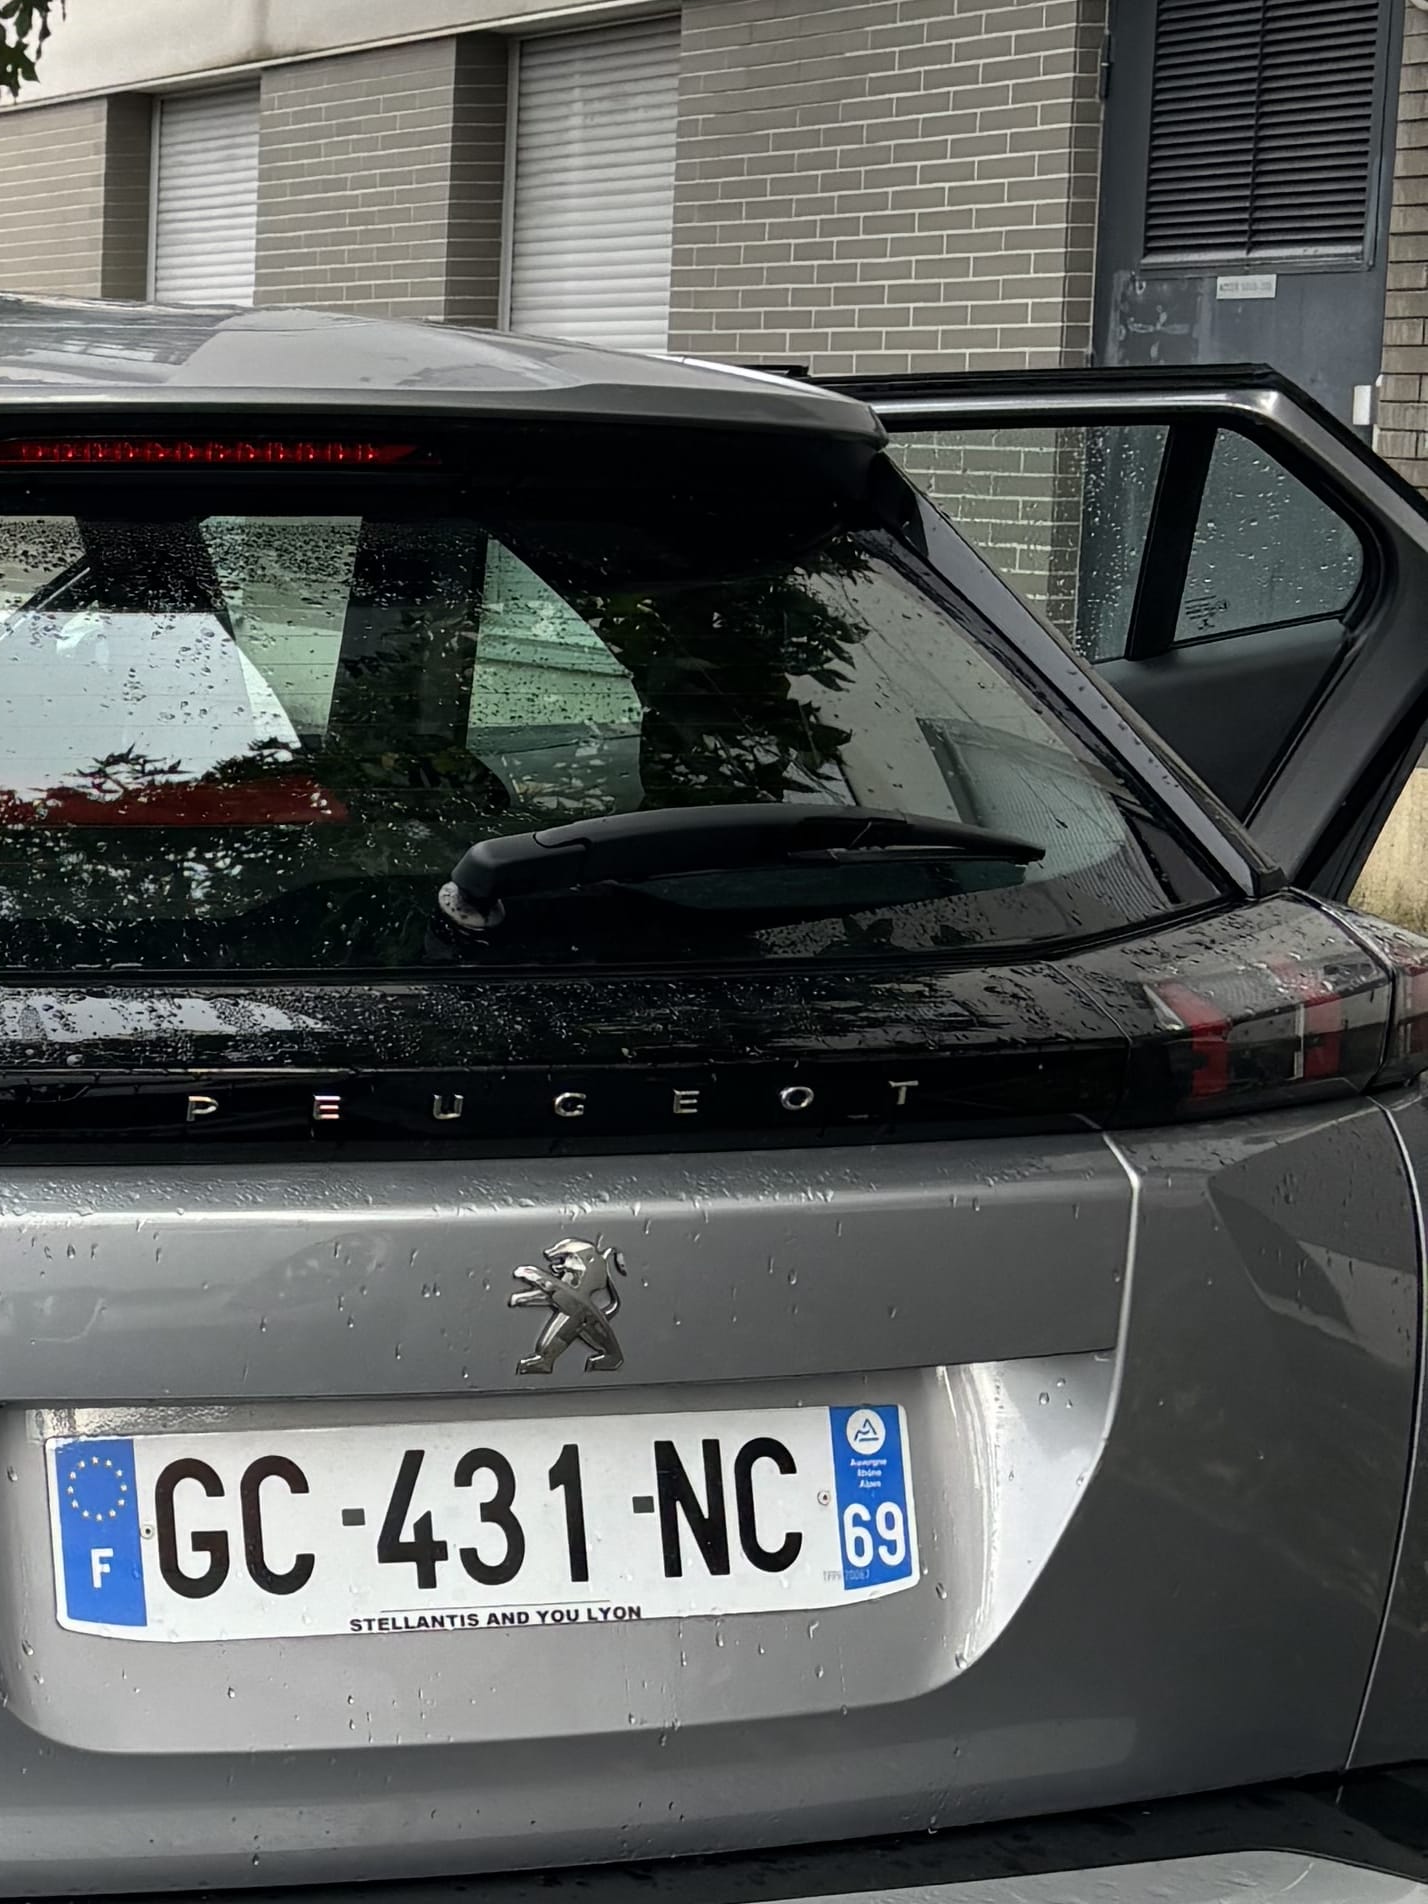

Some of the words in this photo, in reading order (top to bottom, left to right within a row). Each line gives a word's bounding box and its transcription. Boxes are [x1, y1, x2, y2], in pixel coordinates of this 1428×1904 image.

[187, 1080, 919, 1122] PEUGEOT
[843, 1501, 906, 1568] 69
[91, 1548, 114, 1589] F
[350, 1613, 479, 1632] STELLANTIS
[486, 1611, 530, 1627] AND
[535, 1609, 580, 1624] YOU
[587, 1605, 642, 1621] LYON
